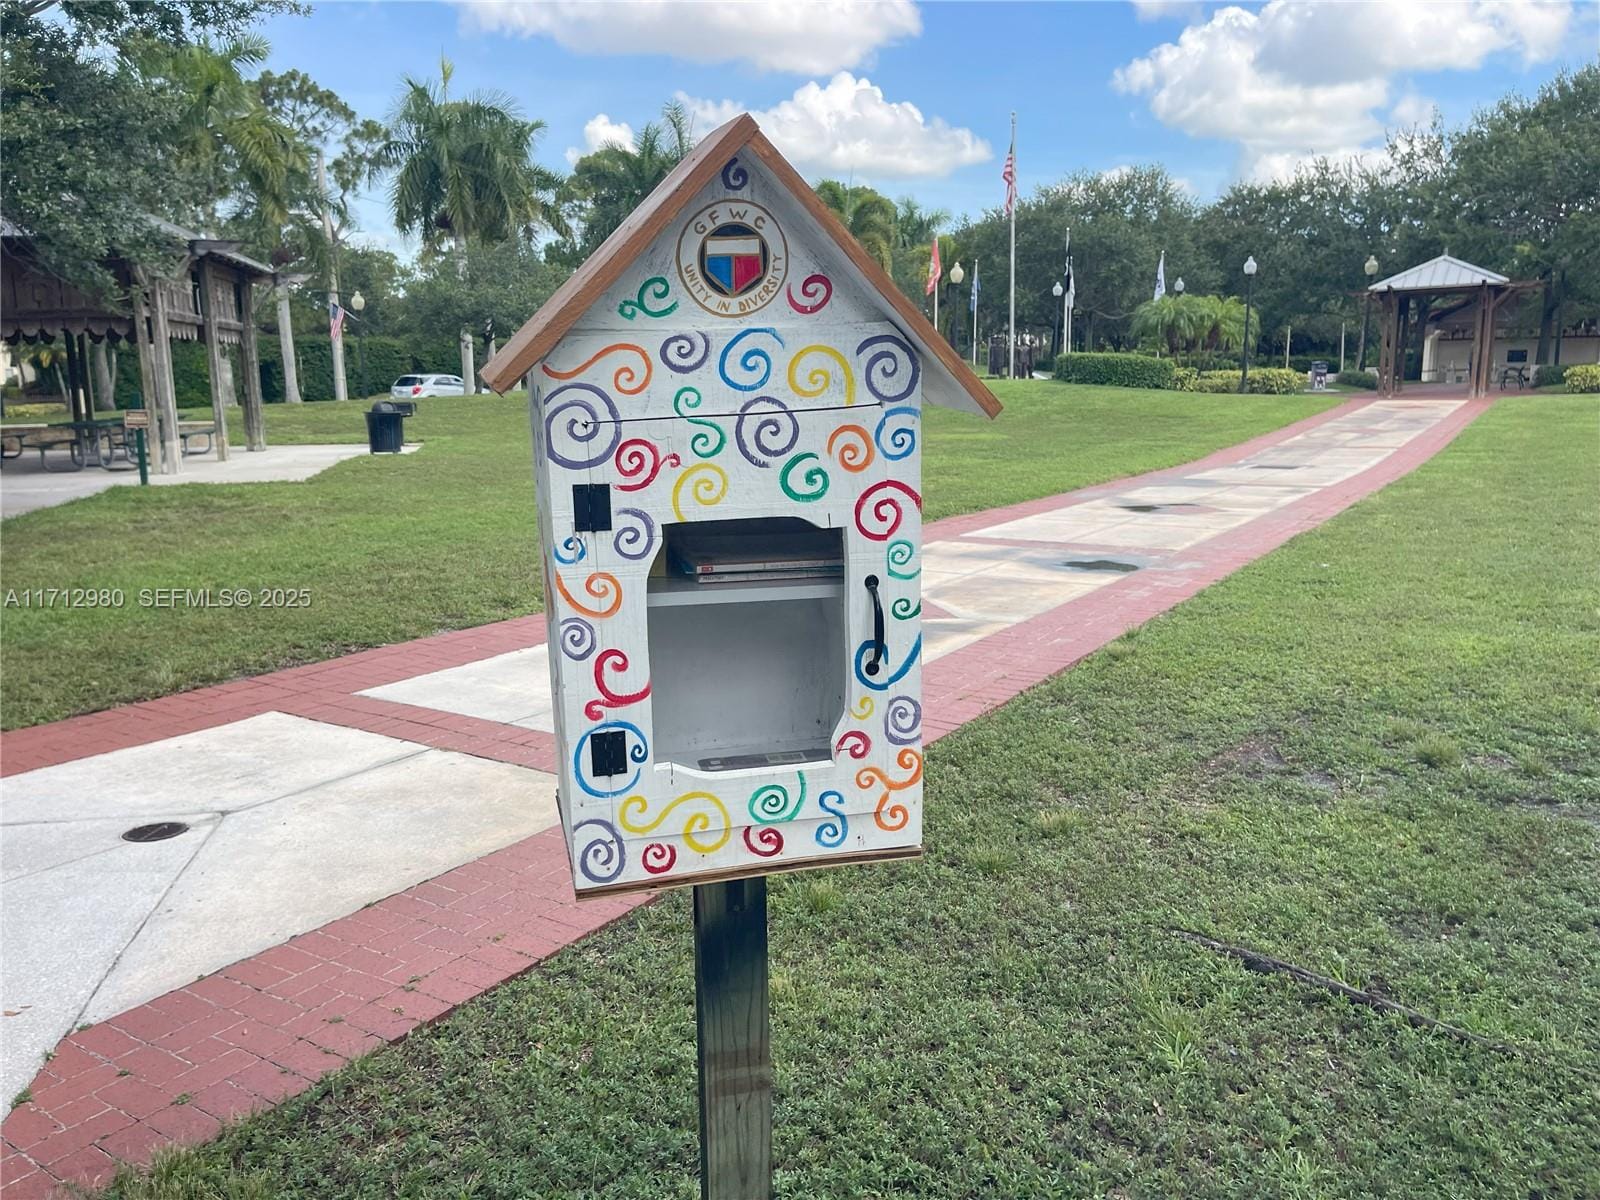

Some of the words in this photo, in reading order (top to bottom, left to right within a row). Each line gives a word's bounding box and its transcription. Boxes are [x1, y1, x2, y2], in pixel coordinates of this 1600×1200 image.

[694, 207, 766, 235] GFWC
[684, 264, 712, 303] UNITY
[717, 300, 731, 312] IN
[738, 253, 782, 312] DIVERSITY
